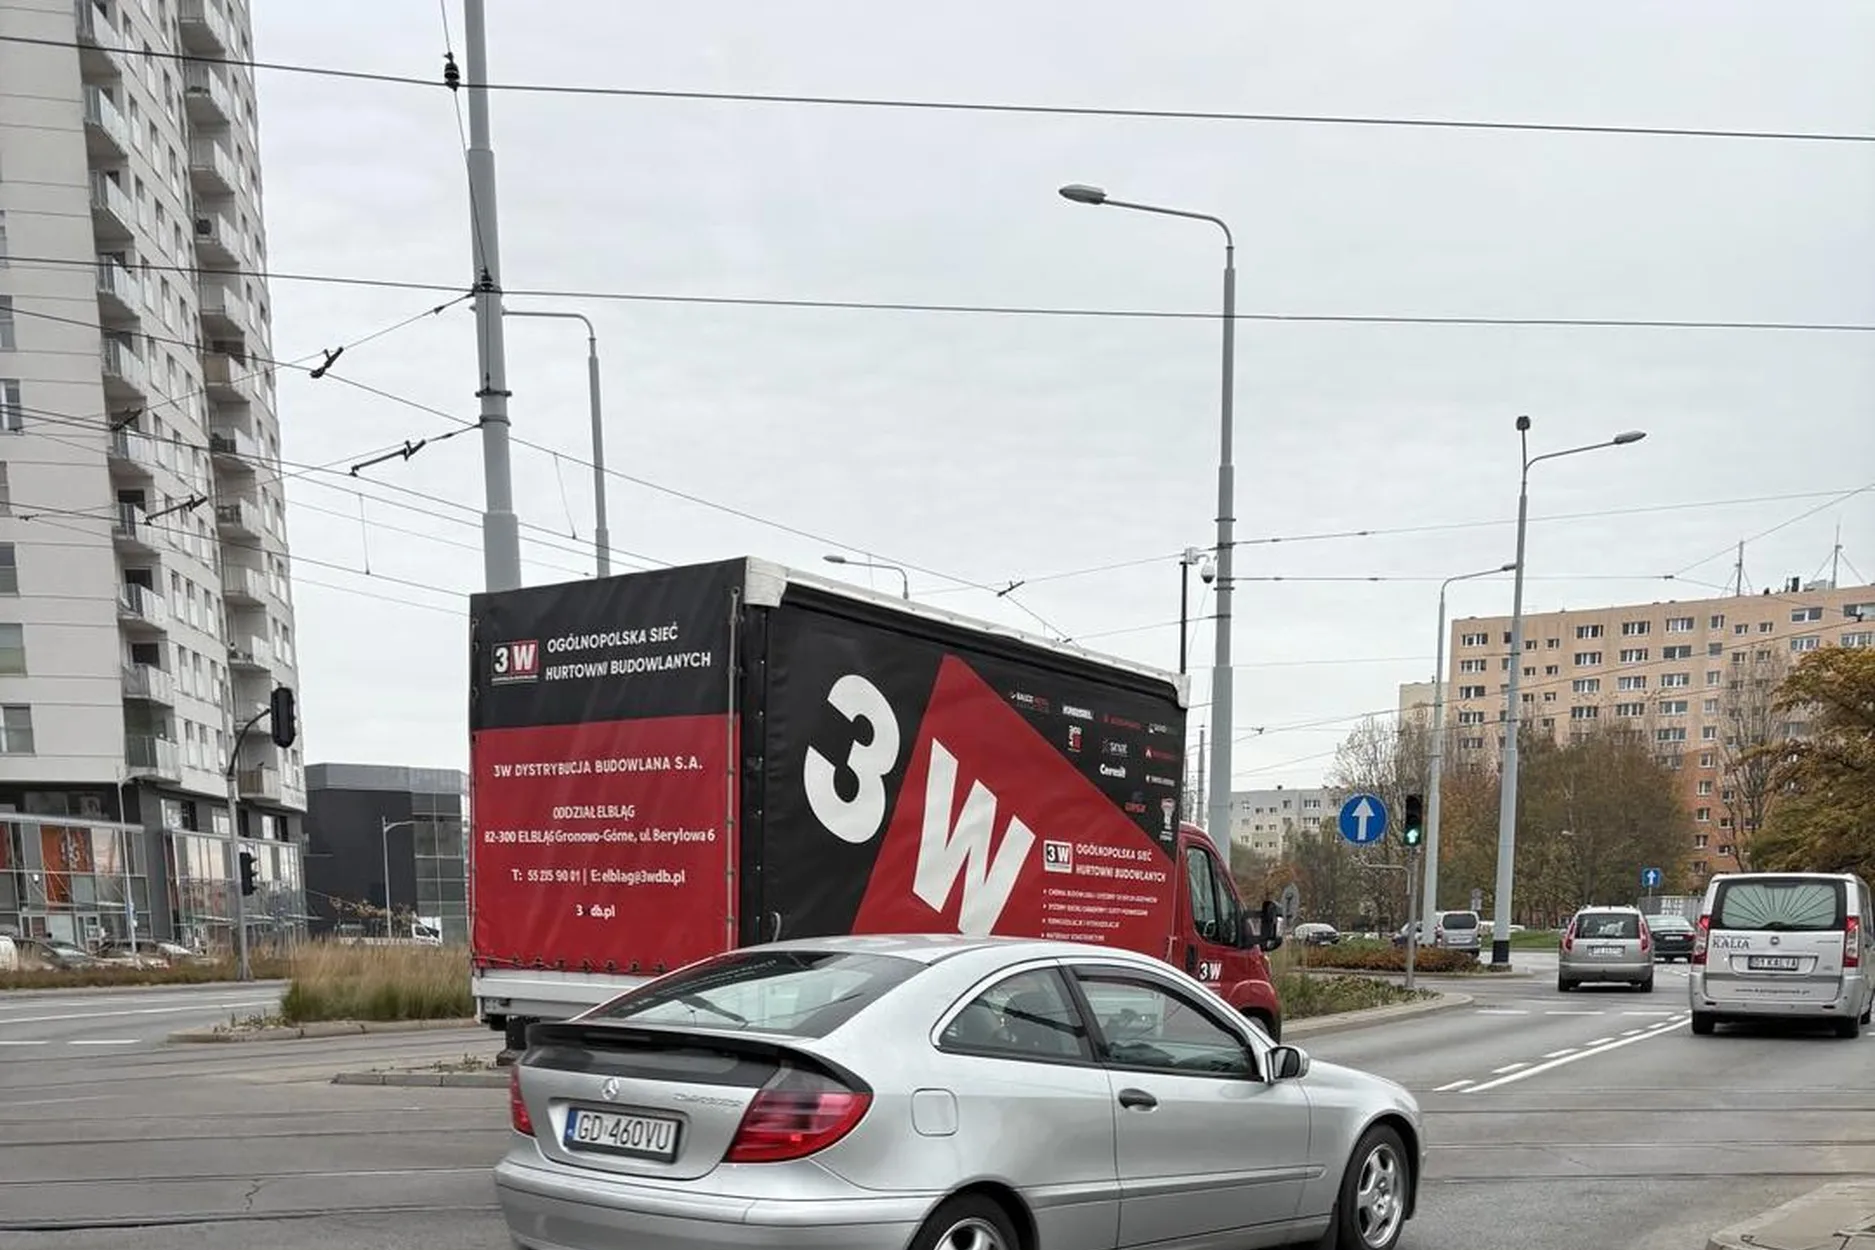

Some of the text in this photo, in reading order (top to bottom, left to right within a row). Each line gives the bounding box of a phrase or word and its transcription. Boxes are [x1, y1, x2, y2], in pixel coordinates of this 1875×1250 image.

[547, 622, 679, 653] OGÓLNOPOLSKA SIEĆ
[494, 643, 535, 673] 3W
[546, 661, 607, 681] HURTOWNI
[610, 652, 712, 675] BUDOWLANYCH
[493, 756, 703, 777] 3W DYSTRYBUCJA BUDOWLANA S.A.
[708, 829, 716, 842] 6
[511, 869, 523, 881] T:
[1200, 962, 1222, 980] 3W
[578, 1114, 671, 1150] GD 460VU
